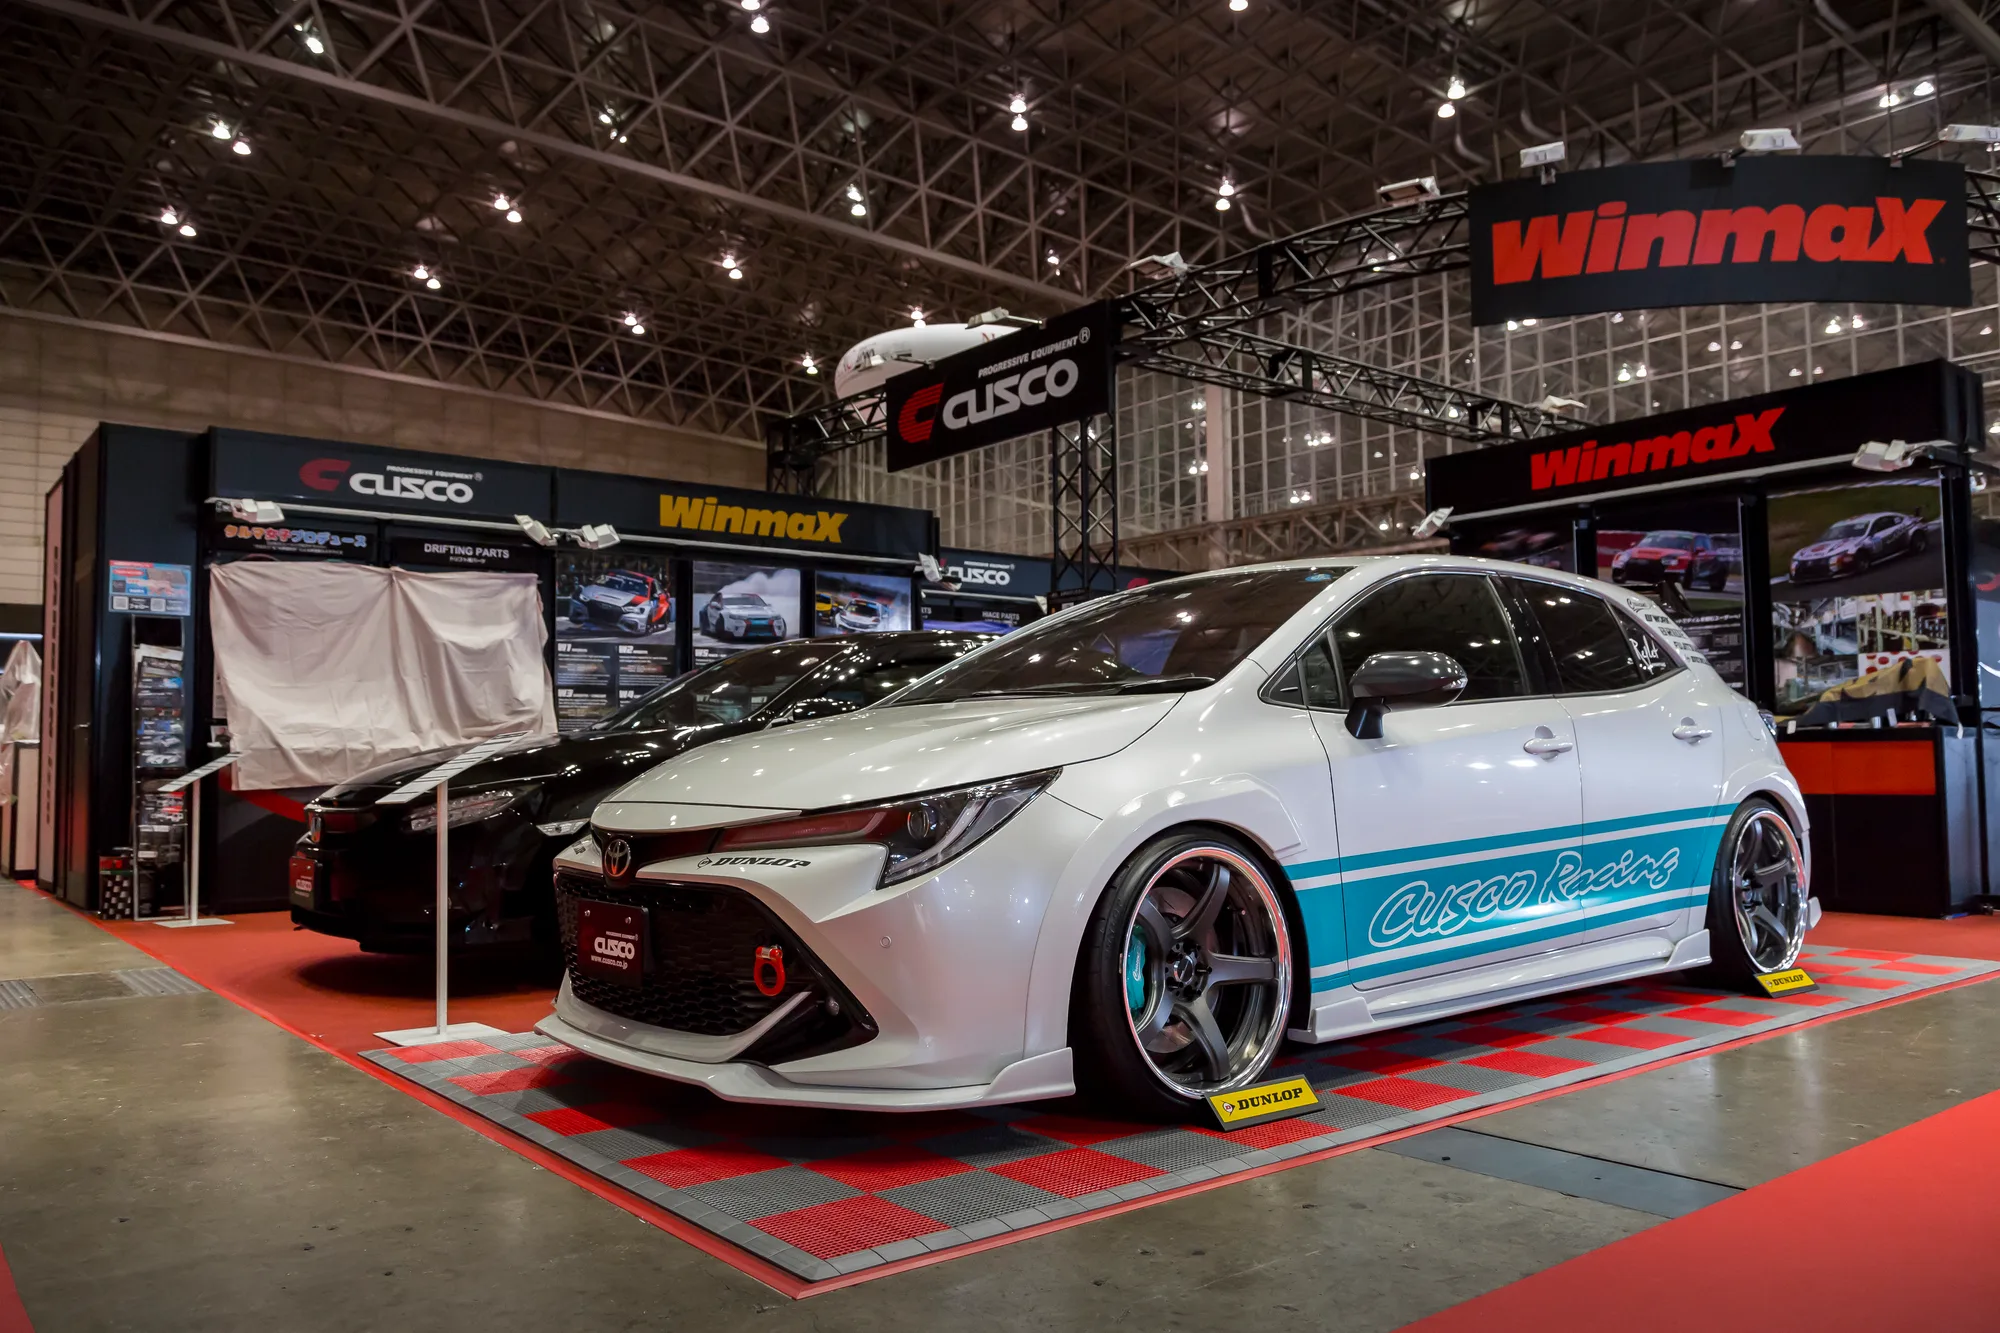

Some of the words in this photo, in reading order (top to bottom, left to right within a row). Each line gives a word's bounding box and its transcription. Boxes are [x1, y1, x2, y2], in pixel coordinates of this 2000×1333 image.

[978, 352, 1030, 379] PROGRESSIVE
[1031, 337, 1078, 360] EQUIPMENT
[942, 358, 1079, 430] CUSCO
[349, 472, 474, 504] CUSCO
[424, 543, 473, 556] DRIFTING
[475, 547, 509, 559] PARTS
[1001, 612, 1020, 621] PARTS
[711, 857, 811, 869] DUNLOP
[1539, 847, 1680, 905] Racing
[594, 937, 635, 960] CUSCO
[1772, 974, 1804, 986] DUNLOP
[1237, 1087, 1303, 1111] DUNLOP
